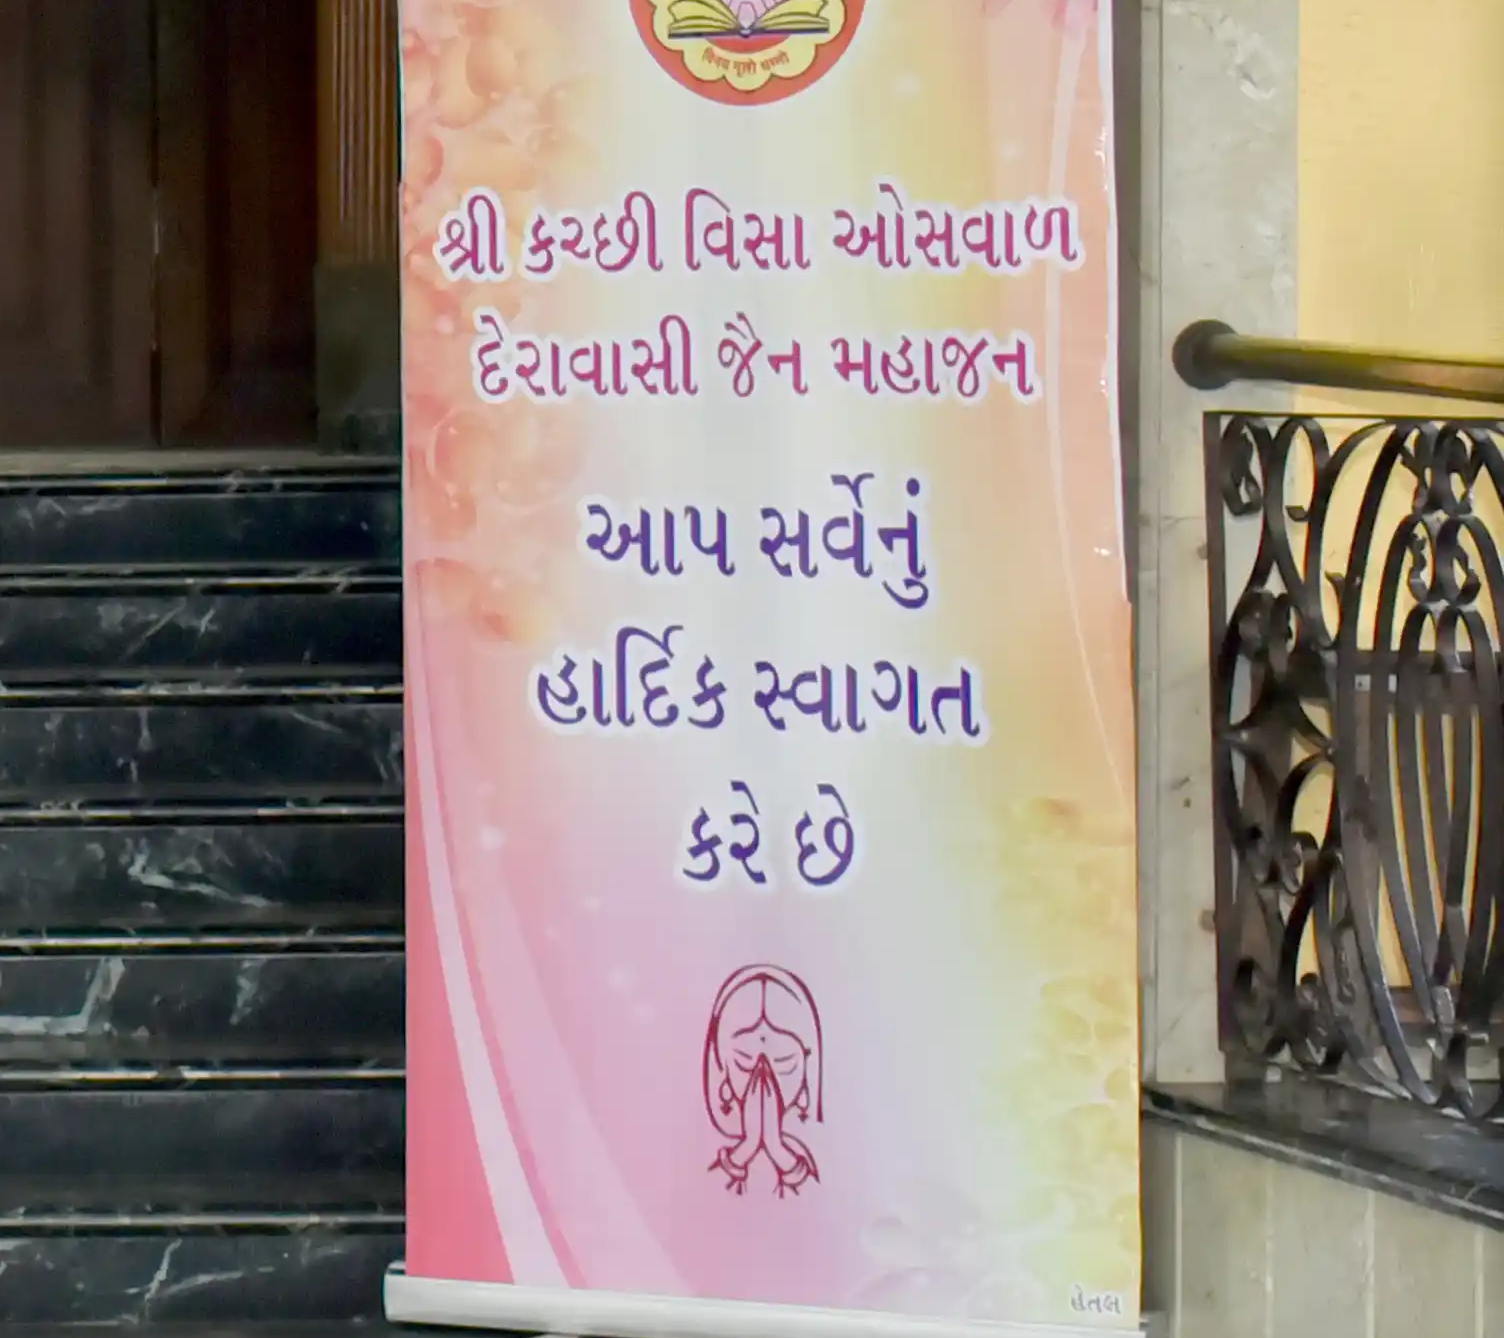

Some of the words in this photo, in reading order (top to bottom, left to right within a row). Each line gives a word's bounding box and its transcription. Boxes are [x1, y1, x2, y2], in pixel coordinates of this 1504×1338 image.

[439, 193, 505, 277] શ્રી
[524, 191, 664, 274] કચ્છી
[685, 187, 812, 272] વિસા
[833, 183, 1080, 272] ઓસવાળ
[474, 313, 700, 396] દેરાવાસી
[717, 312, 809, 396] જૈન
[829, 336, 1036, 397] મહાજન
[585, 502, 732, 577] આપ
[759, 472, 929, 610] સર્વેનું
[536, 625, 728, 729] હાર્દિક
[753, 658, 983, 737] સ્વાગત
[683, 779, 769, 886] કરે
[794, 783, 857, 886] છે
